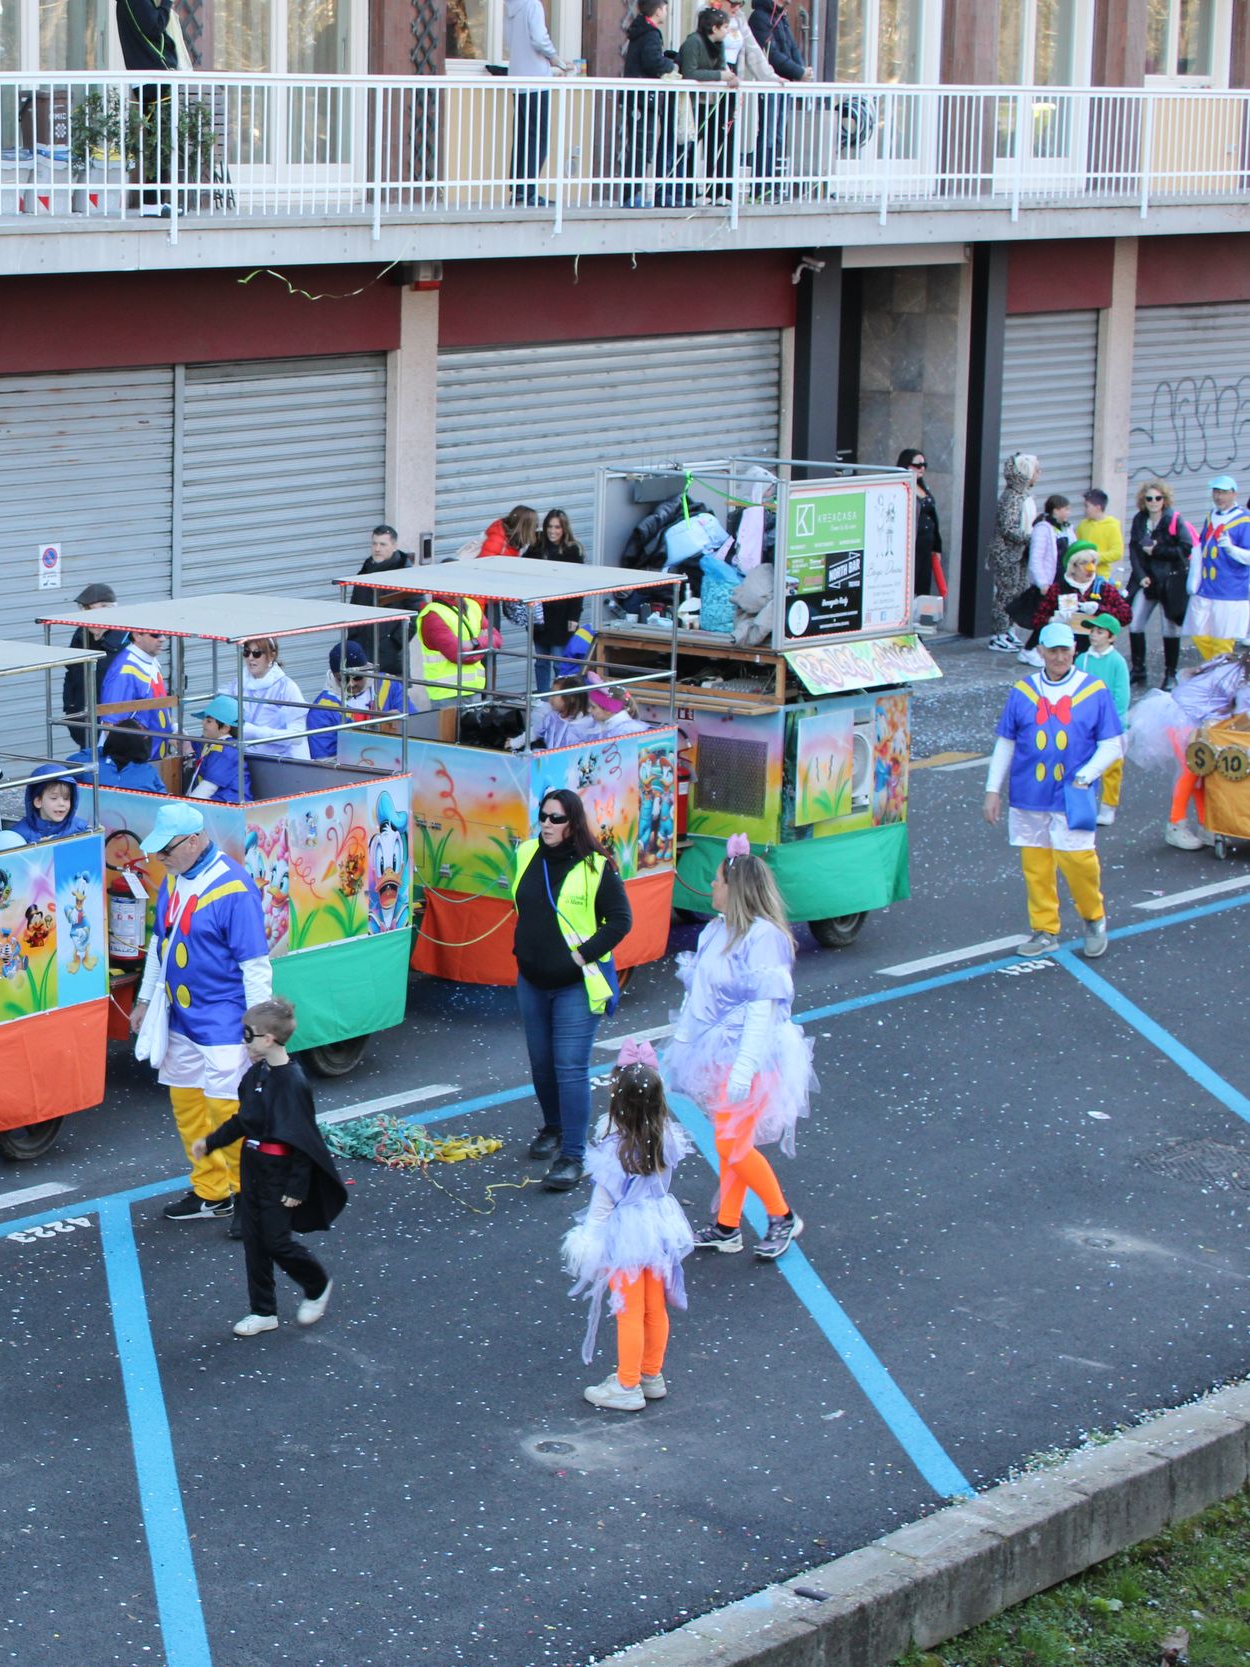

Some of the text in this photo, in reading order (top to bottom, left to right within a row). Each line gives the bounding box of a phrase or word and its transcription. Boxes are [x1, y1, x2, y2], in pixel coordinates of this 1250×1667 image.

[828, 562, 848, 582] NORTH
[848, 558, 861, 574] BAR
[1221, 755, 1242, 773] 10
[6, 1216, 92, 1243] 4223
